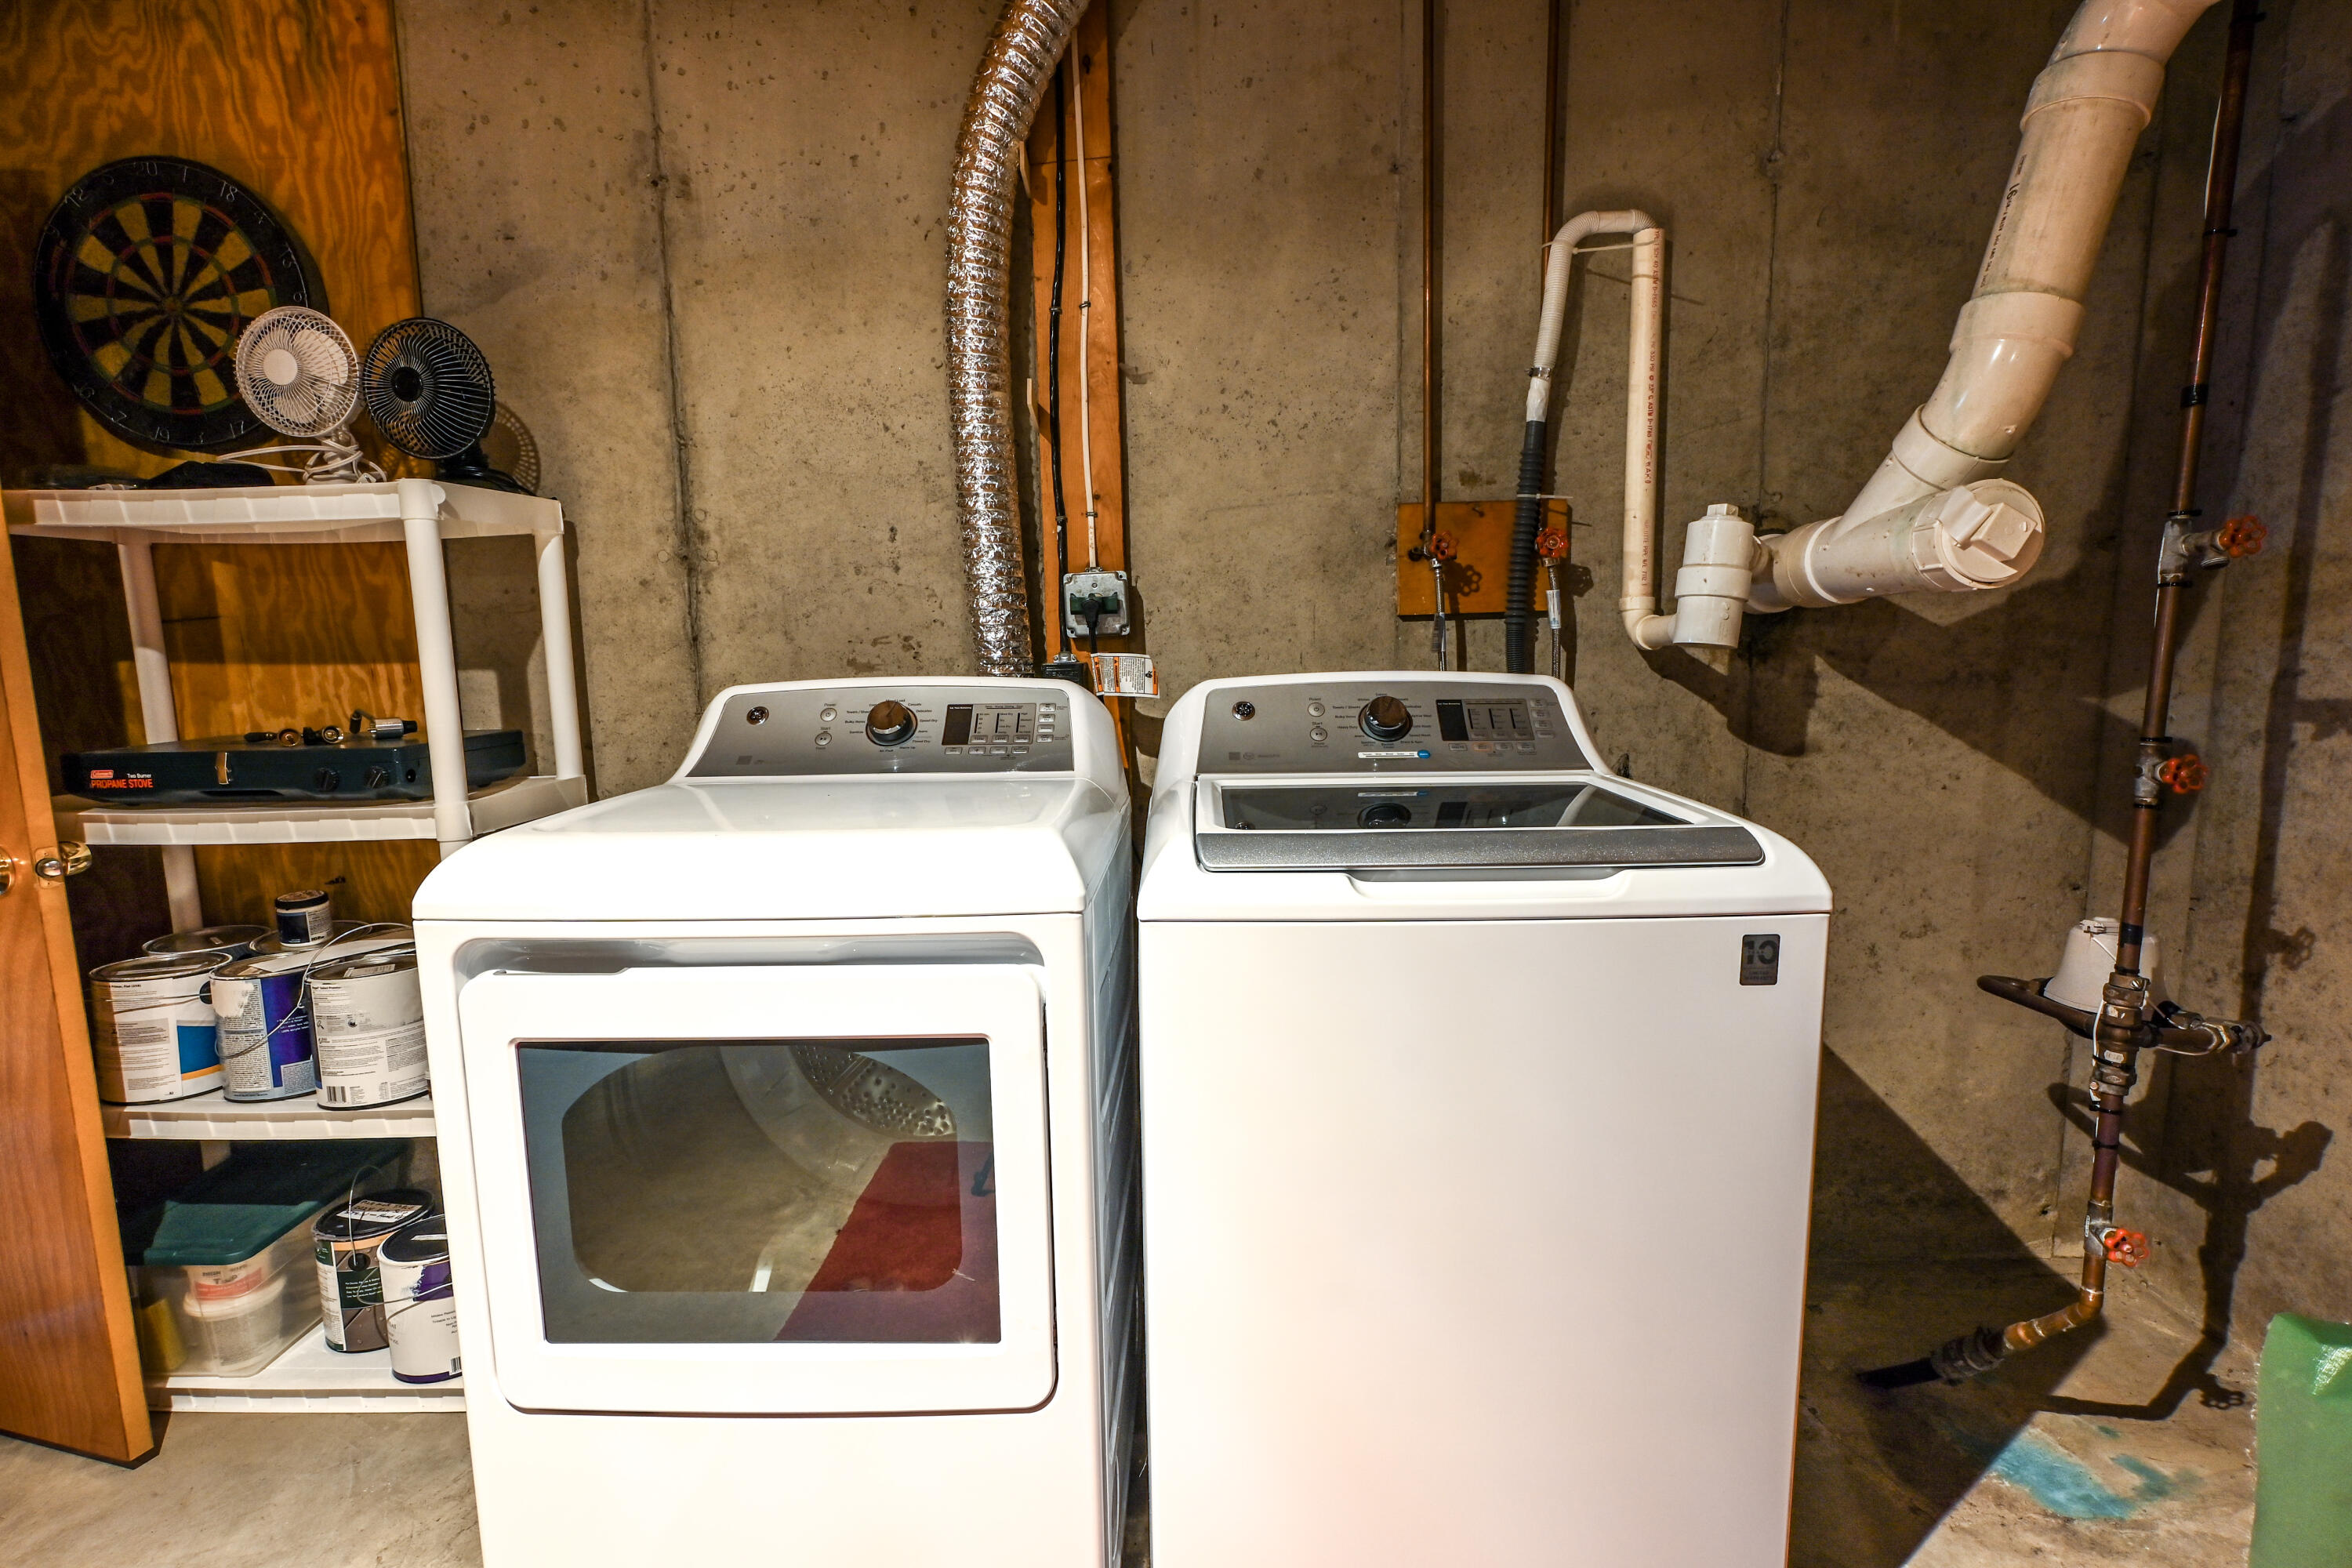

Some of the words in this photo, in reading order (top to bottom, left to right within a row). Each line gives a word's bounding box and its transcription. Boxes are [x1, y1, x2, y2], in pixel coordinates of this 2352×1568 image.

[220, 181, 238, 202] 18
[91, 779, 127, 789] PROPANE
[128, 779, 154, 788] STOVE
